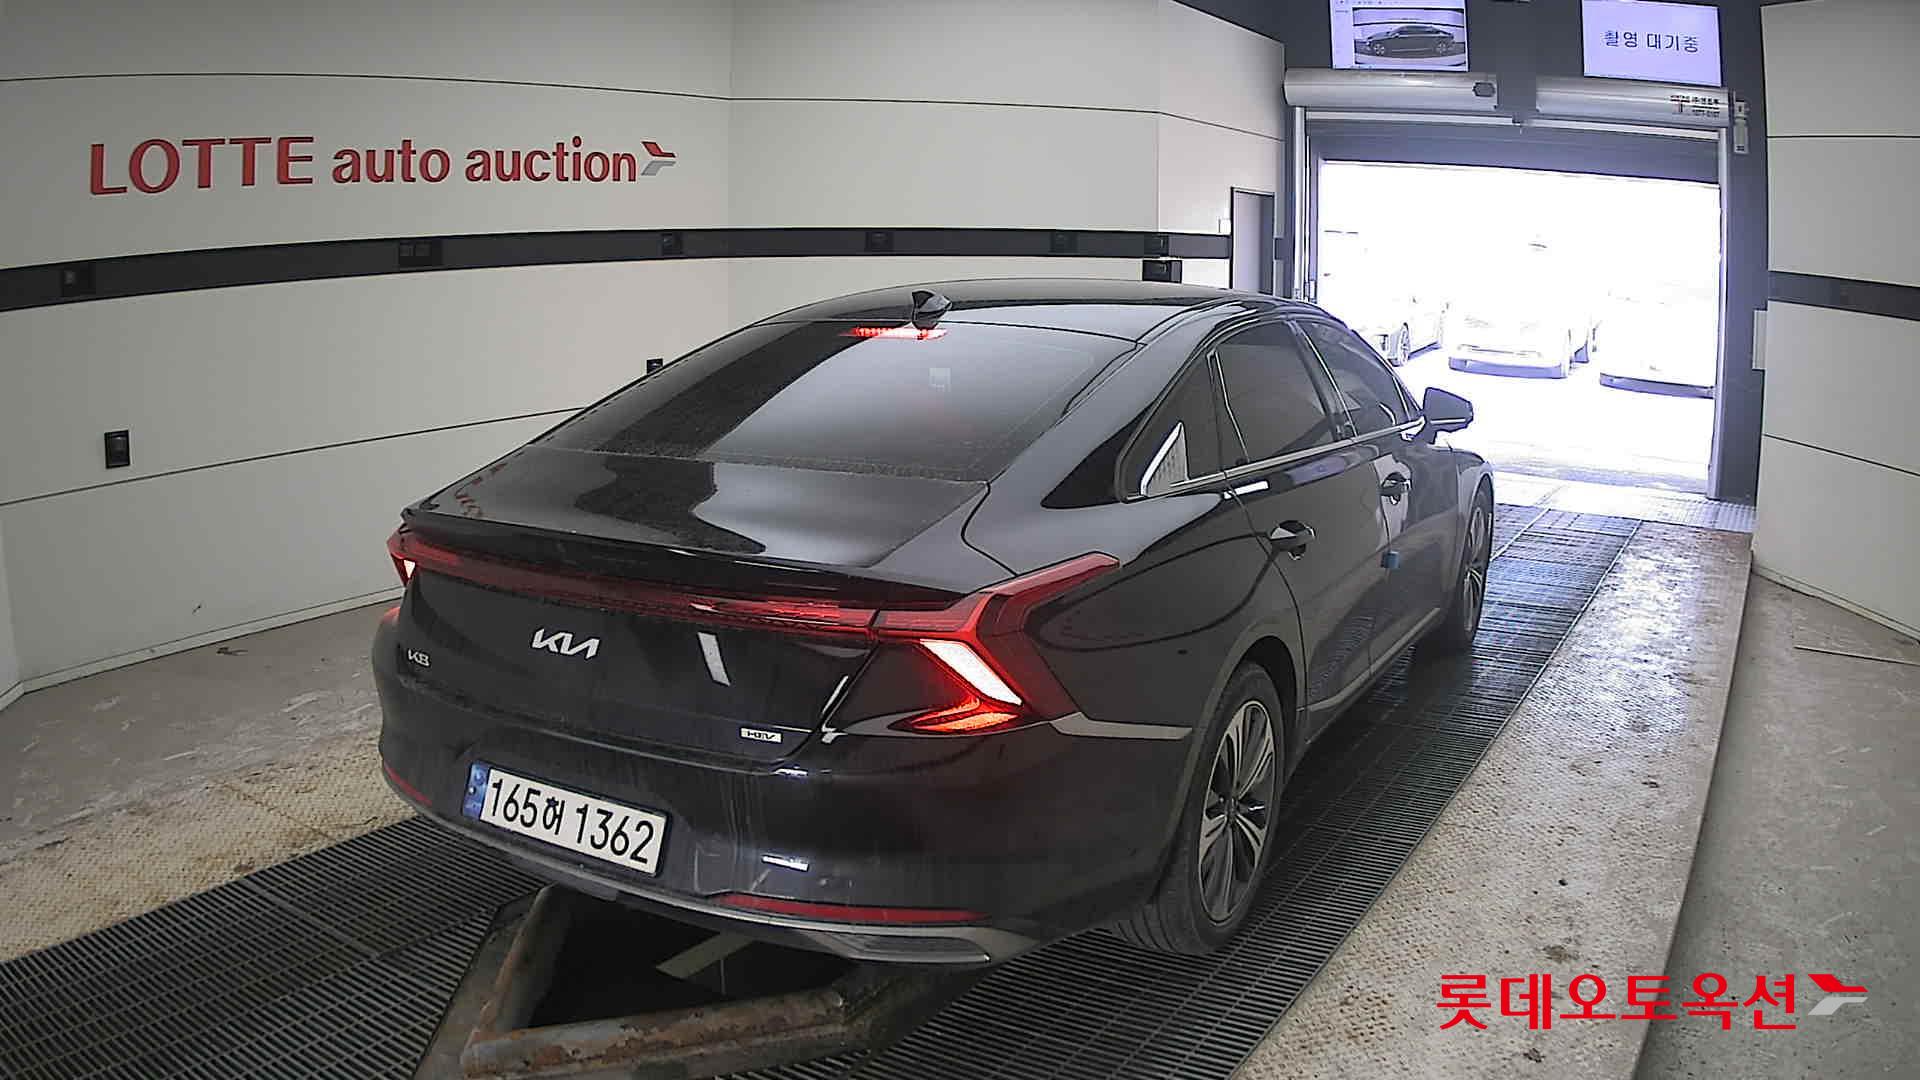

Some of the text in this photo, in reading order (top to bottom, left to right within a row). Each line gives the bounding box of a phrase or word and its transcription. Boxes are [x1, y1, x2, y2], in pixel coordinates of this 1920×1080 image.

[1604, 30, 1698, 53] 촬영 대기중
[89, 135, 638, 195] LOTTE auto auction
[531, 628, 600, 660] KIA
[575, 803, 655, 864] 1362
